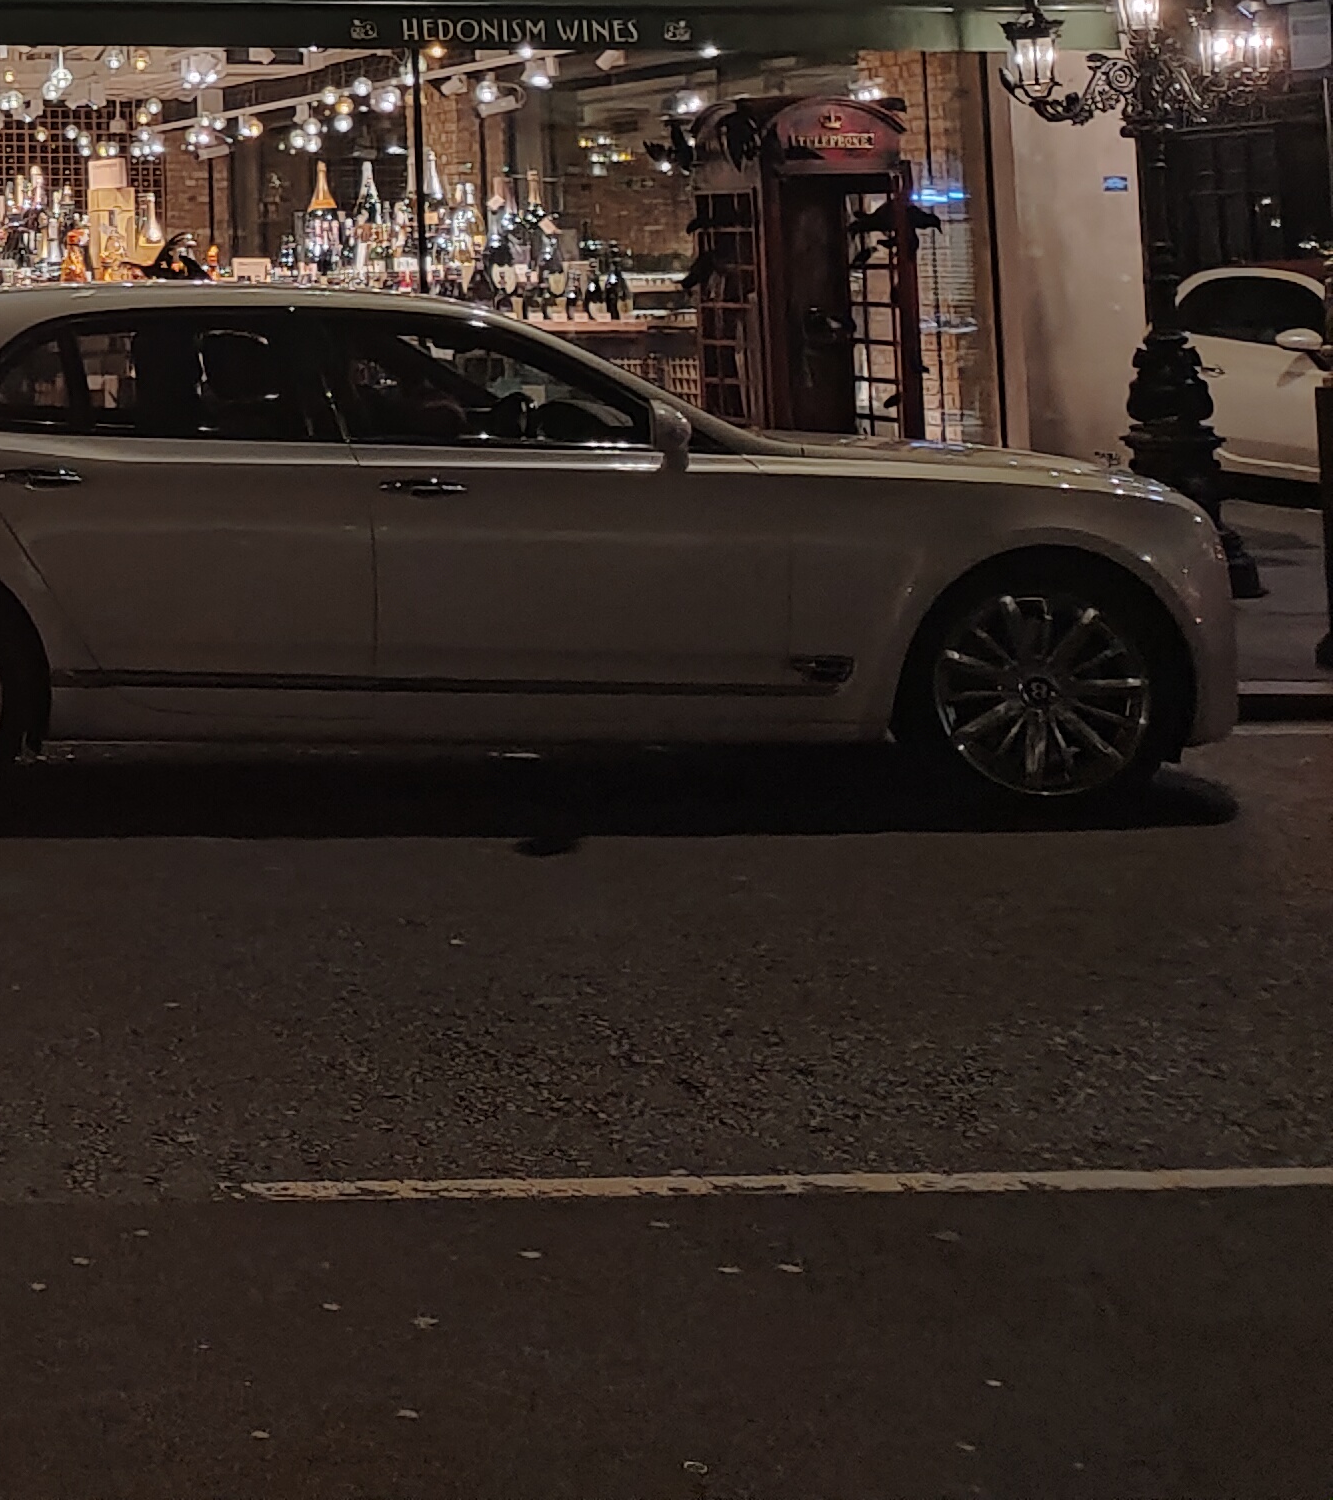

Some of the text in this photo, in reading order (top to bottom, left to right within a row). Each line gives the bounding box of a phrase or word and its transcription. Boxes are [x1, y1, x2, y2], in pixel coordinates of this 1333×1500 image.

[401, 17, 638, 43] HEDONISM WINES
[797, 134, 869, 148] TELEPHONE
